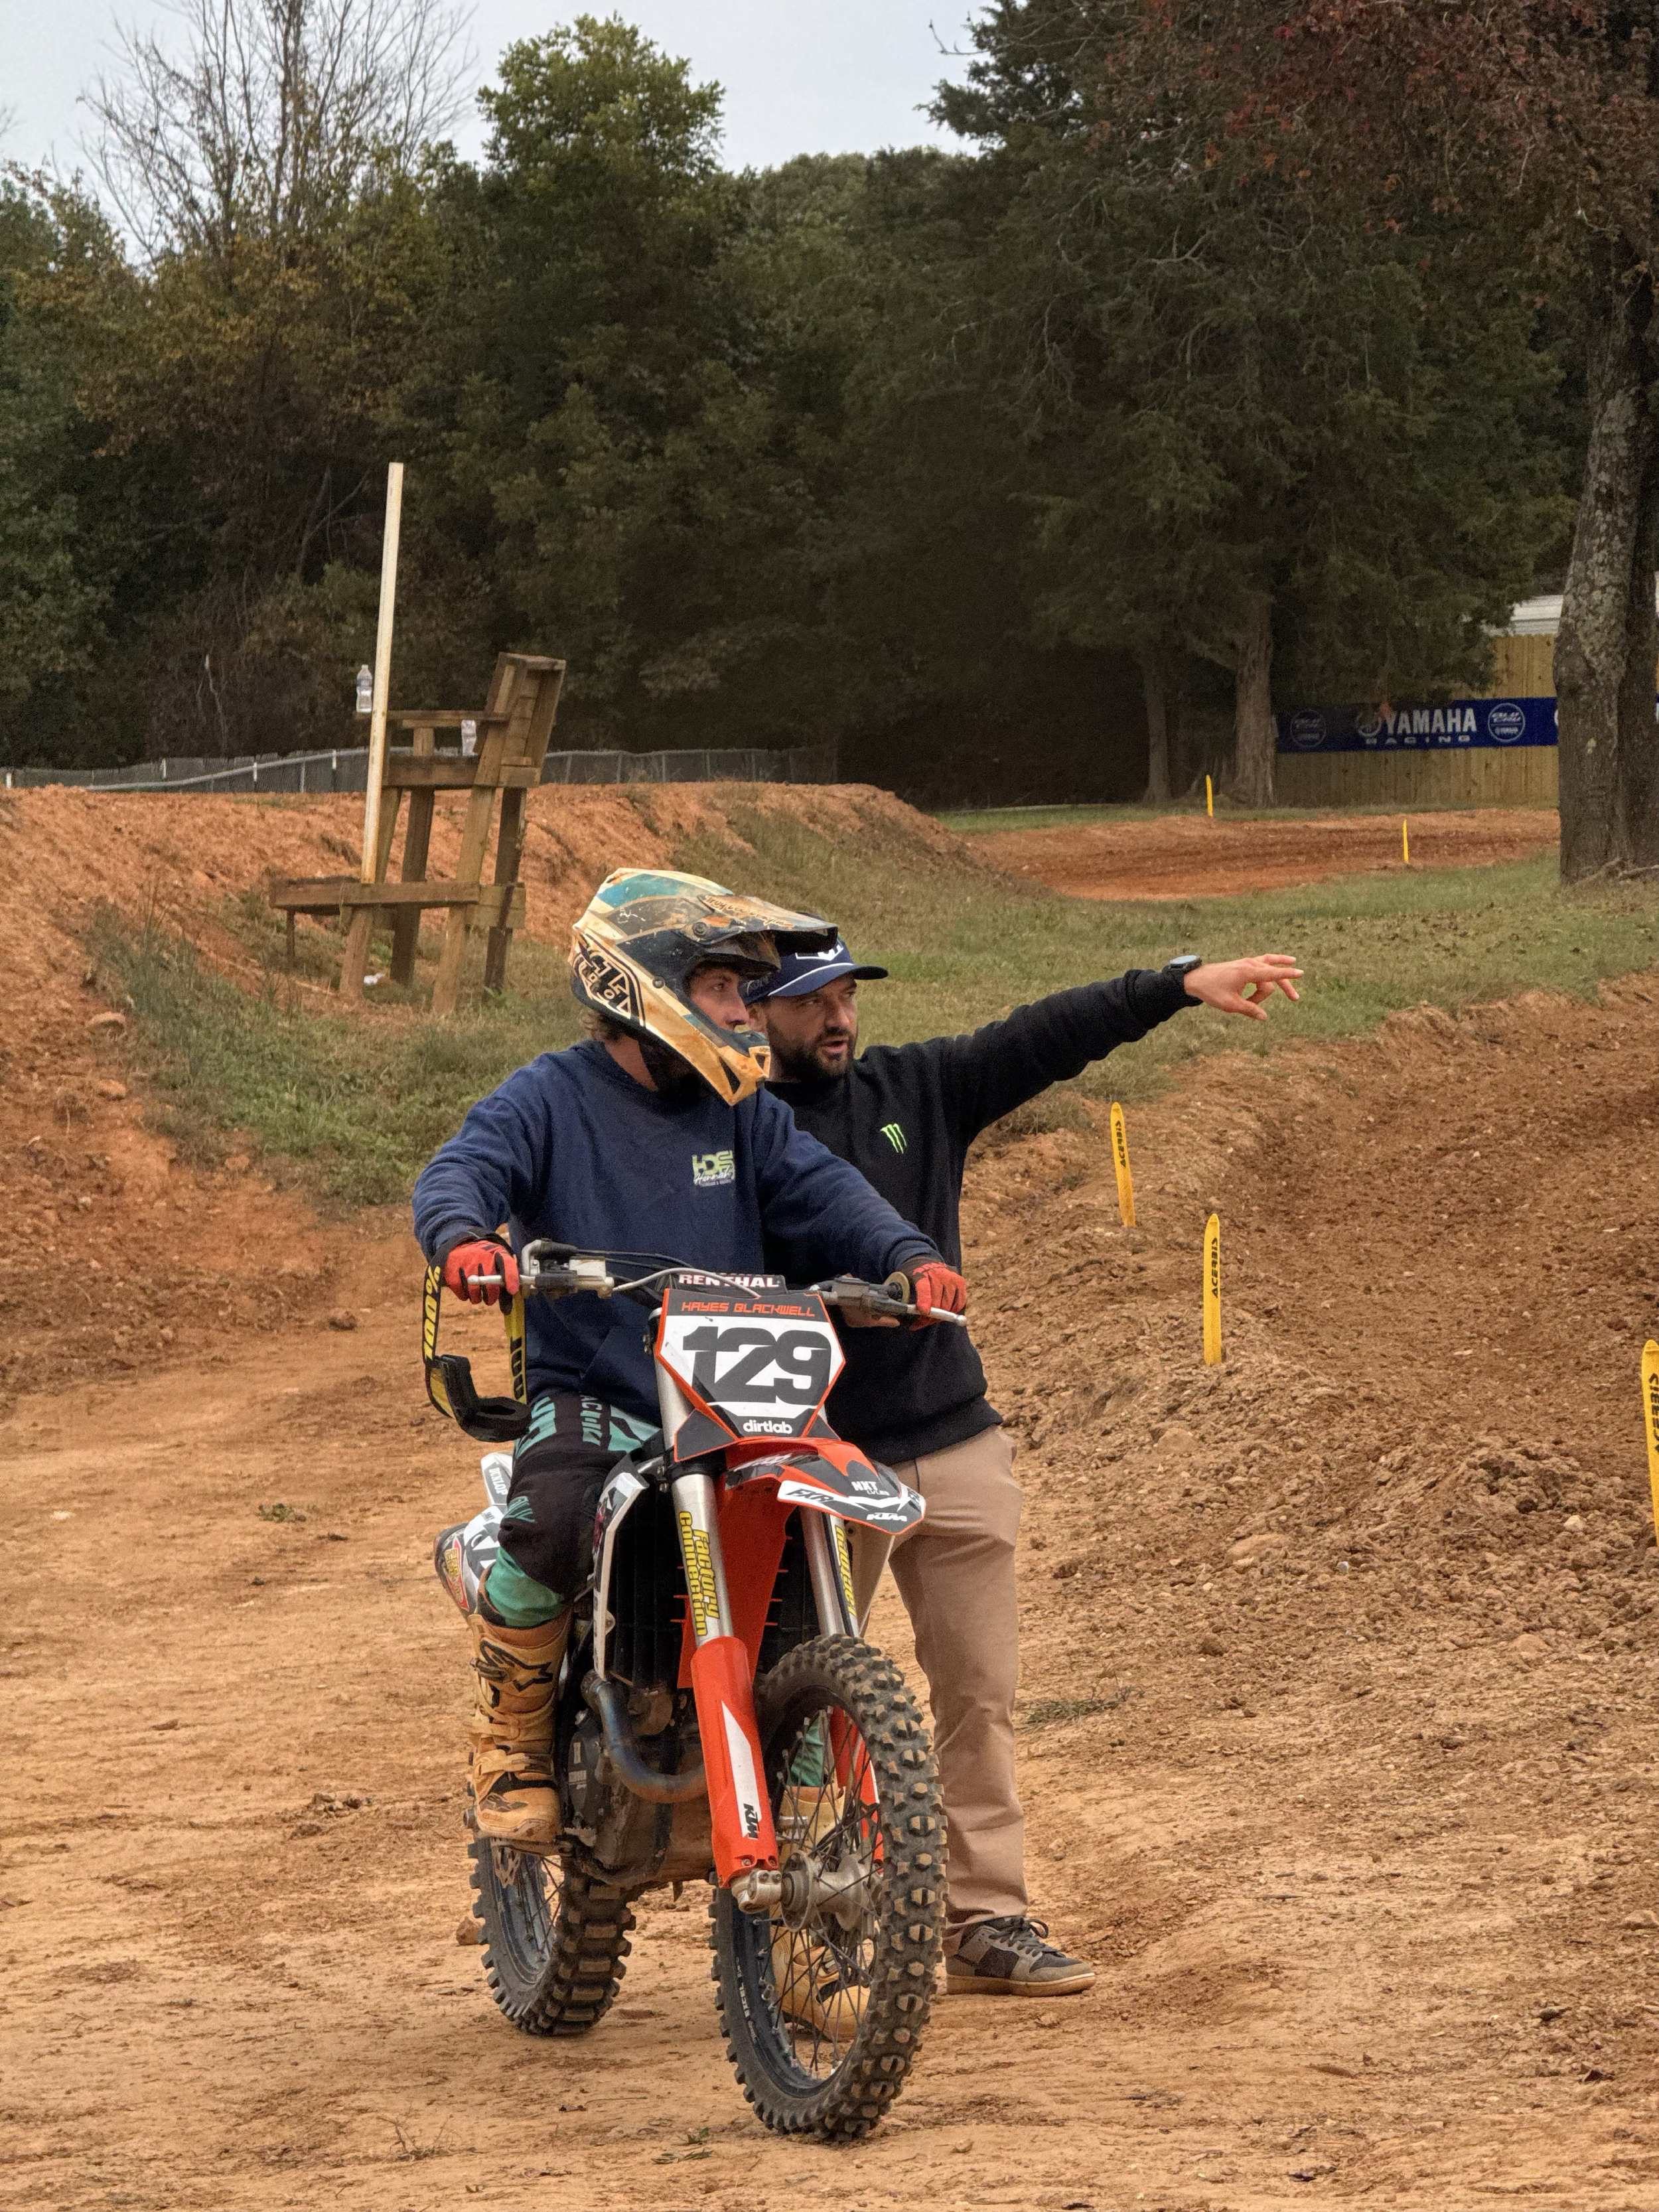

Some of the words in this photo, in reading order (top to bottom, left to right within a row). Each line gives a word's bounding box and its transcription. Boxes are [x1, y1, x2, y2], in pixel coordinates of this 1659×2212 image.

[1385, 707, 1477, 734] YAMAHA
[1115, 1120, 1127, 1169] ACERBIS
[423, 1264, 441, 1361] 100%
[681, 1301, 729, 1313] HAYES
[733, 1302, 816, 1317] BLACKWELL
[683, 1325, 832, 1406] 129
[743, 1419, 793, 1435] dirtlab
[488, 1467, 509, 1495] DUNLOP
[851, 1481, 879, 1491] NXT
[866, 1512, 908, 1522] KTM
[679, 1511, 708, 1637] Connection
[693, 1528, 721, 1619] Factory
[743, 1803, 760, 1839] KTM
